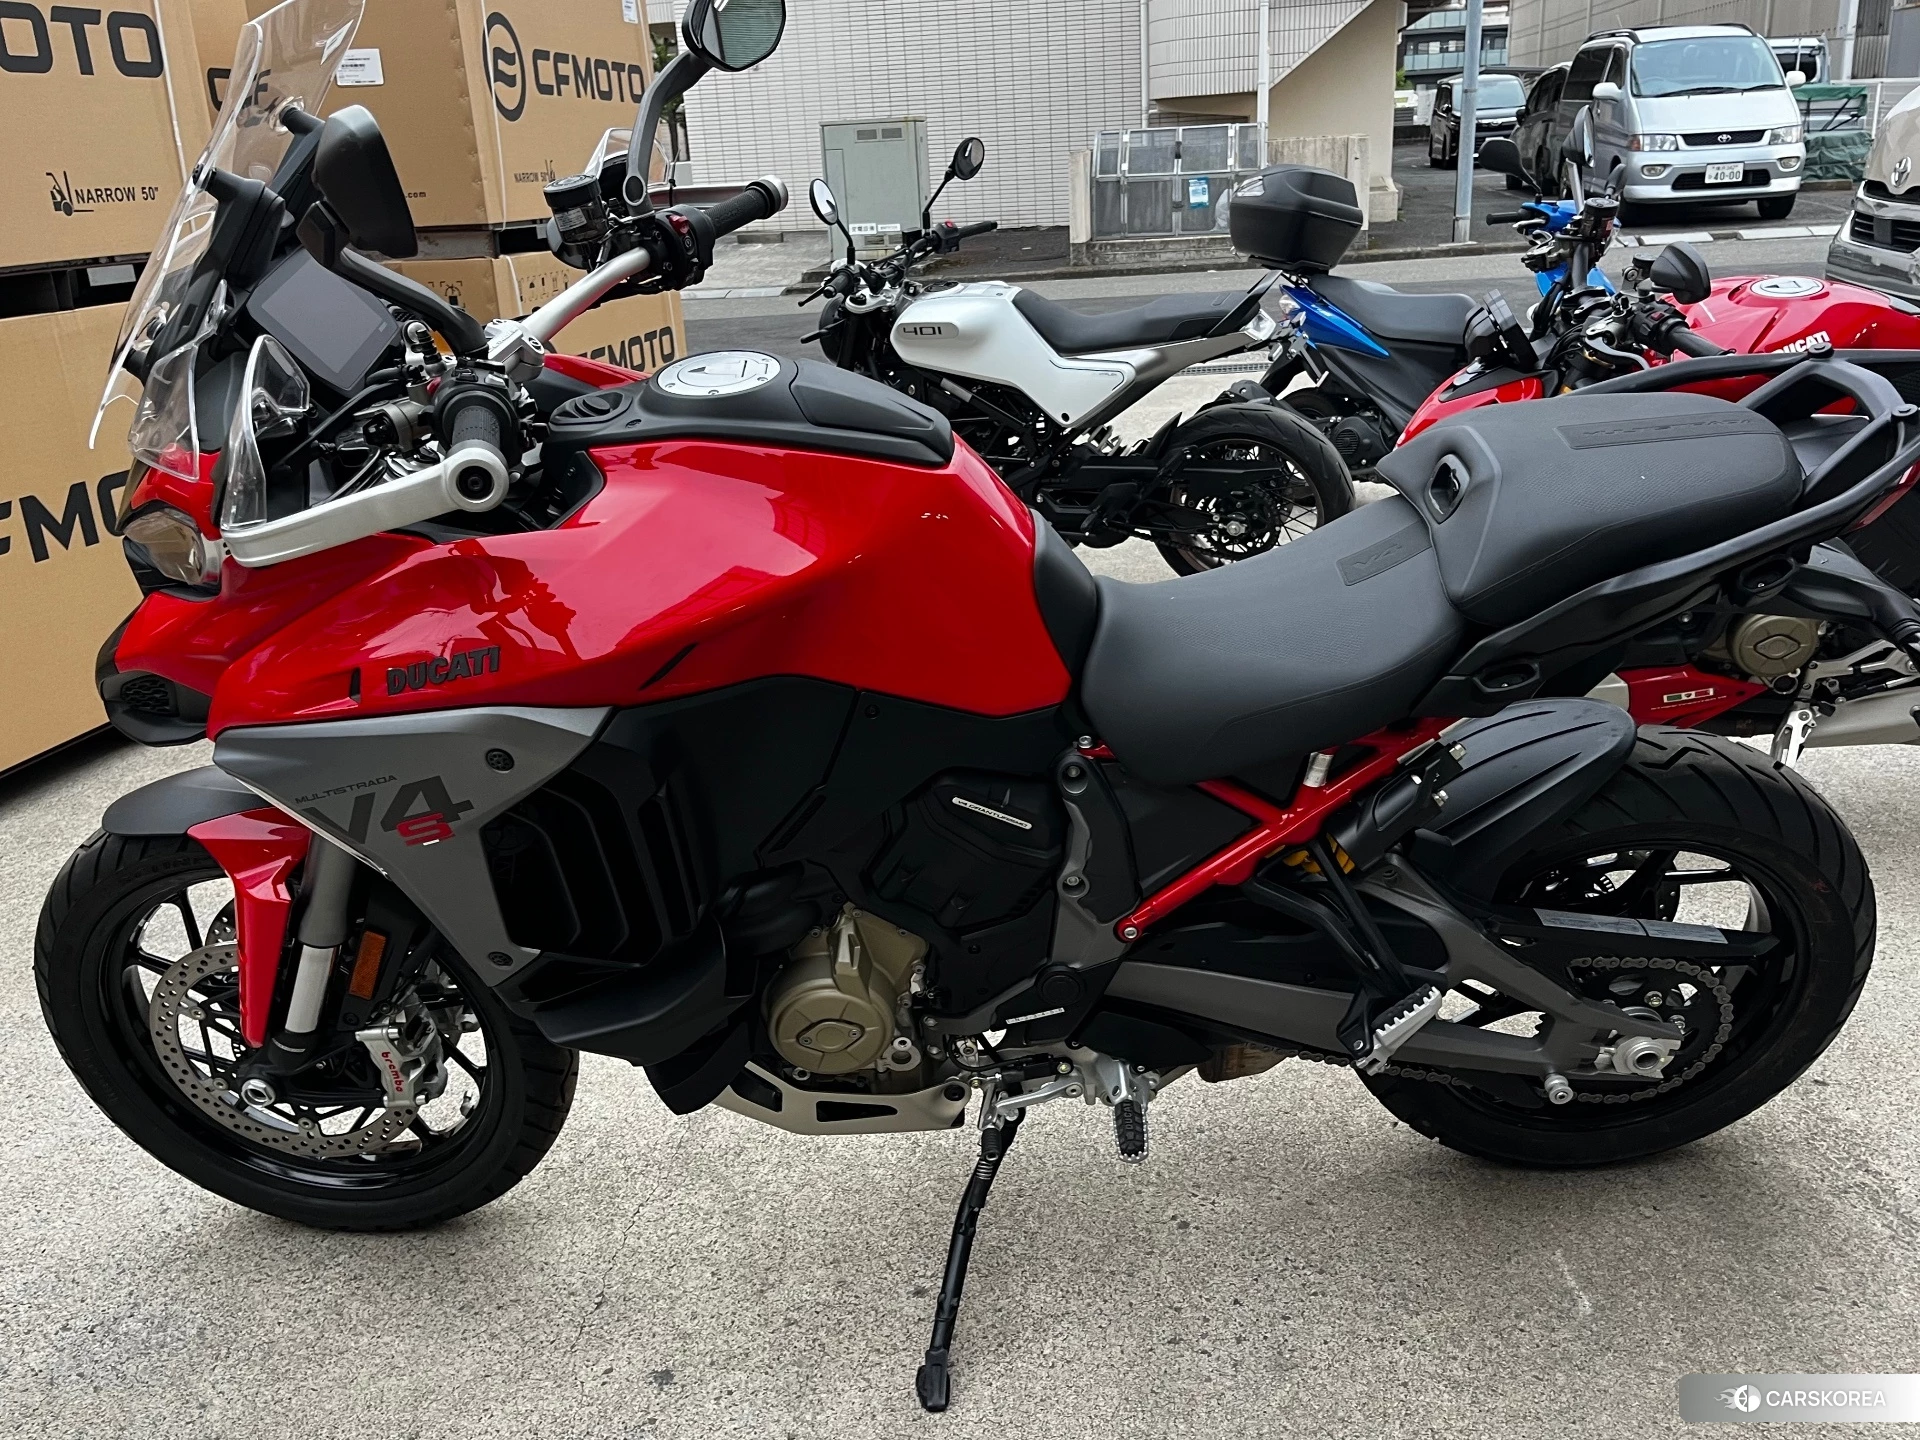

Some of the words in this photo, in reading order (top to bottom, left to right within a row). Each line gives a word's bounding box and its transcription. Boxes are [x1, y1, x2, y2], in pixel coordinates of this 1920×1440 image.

[532, 48, 645, 104] CFMOTO
[1714, 171, 1741, 181] 40-00
[75, 187, 136, 204] NARROW
[142, 187, 159, 201] 50"
[386, 645, 501, 696] DUCATI
[295, 775, 397, 804] MULTISTRADA
[302, 775, 475, 845] V4
[396, 812, 456, 847] S
[381, 1051, 404, 1093] brembo
